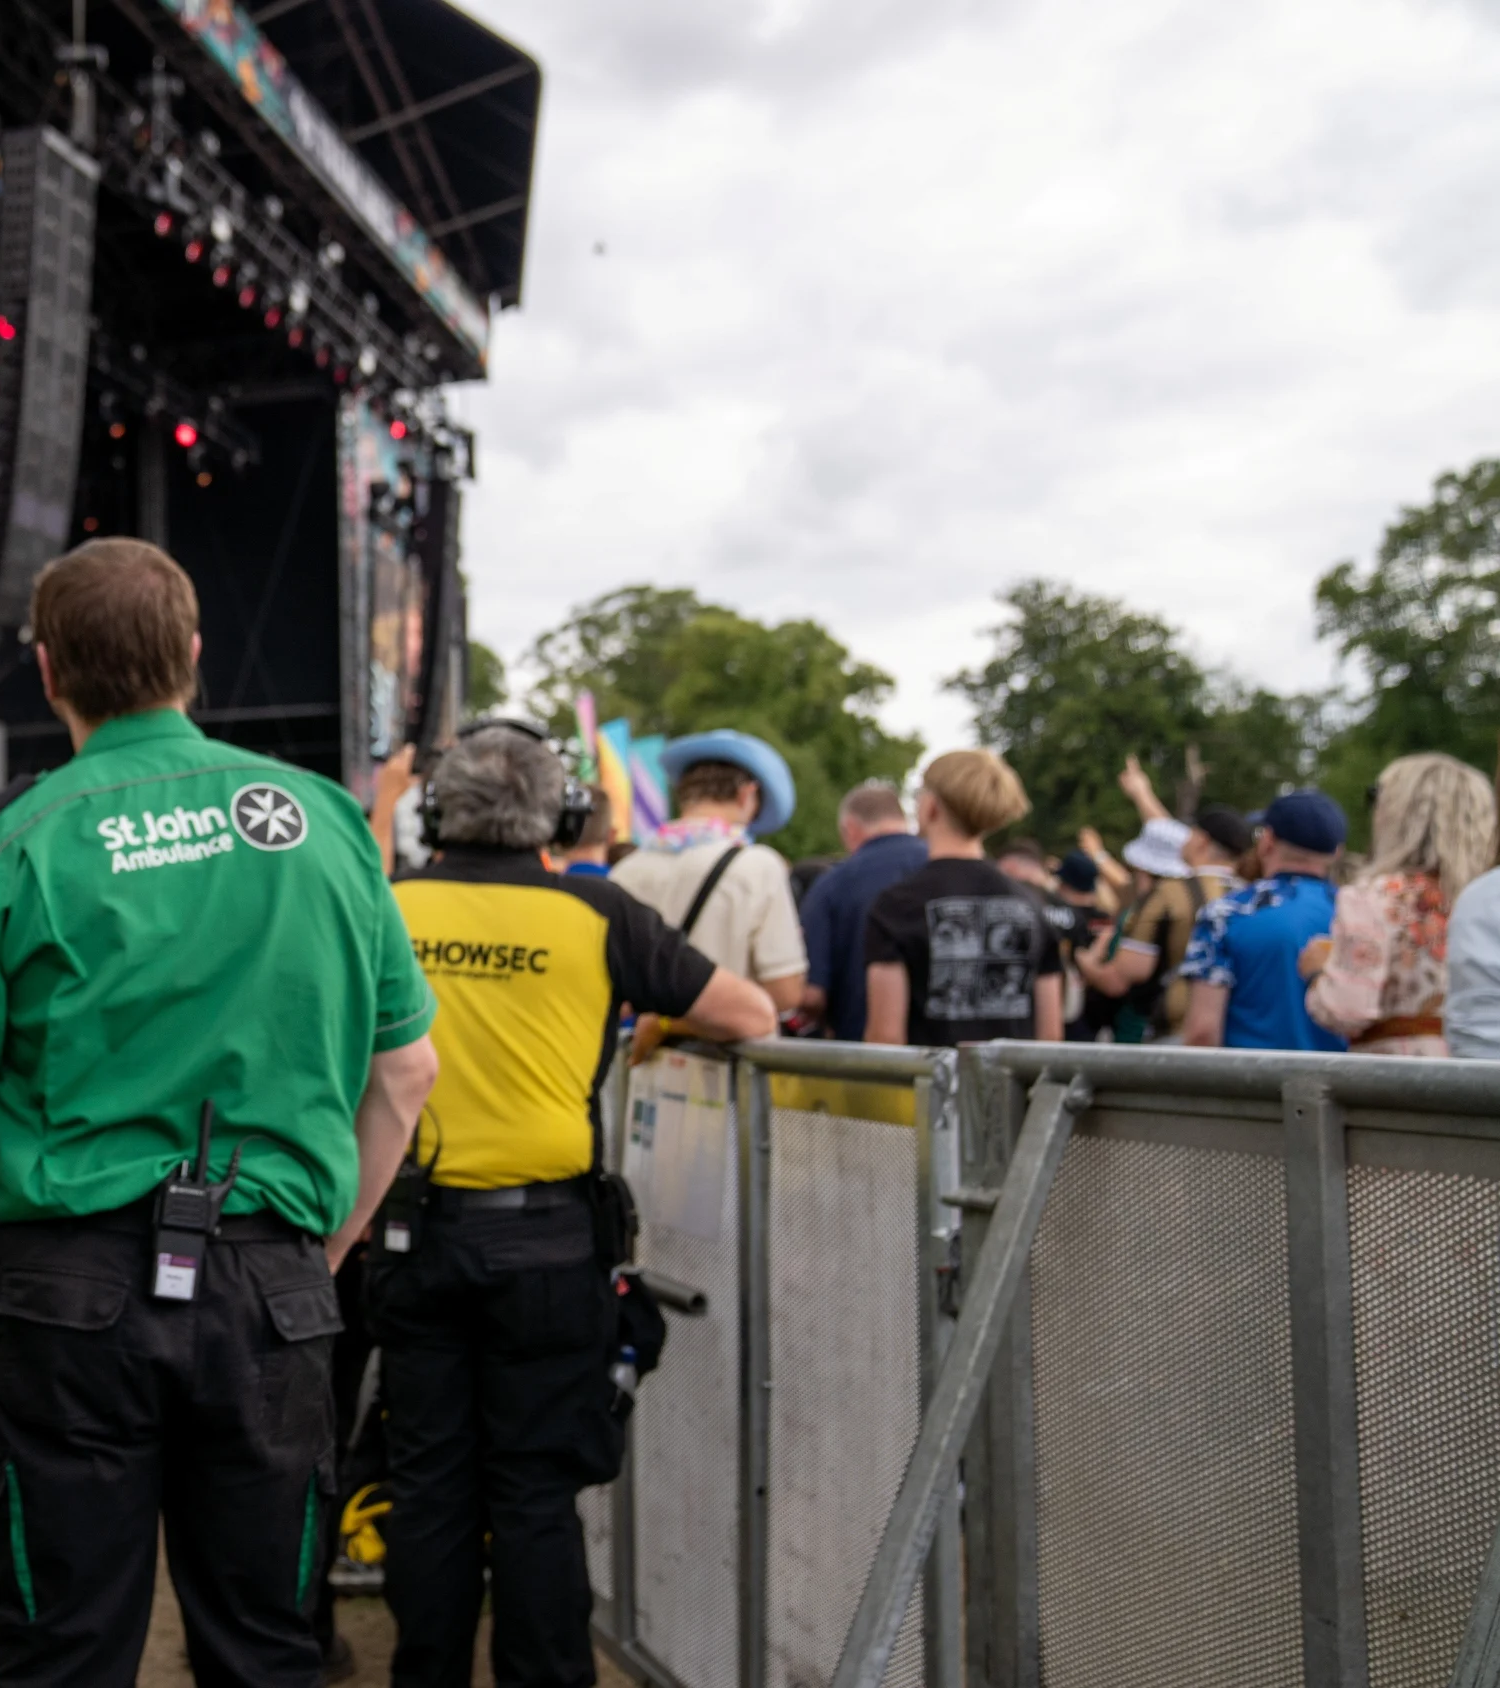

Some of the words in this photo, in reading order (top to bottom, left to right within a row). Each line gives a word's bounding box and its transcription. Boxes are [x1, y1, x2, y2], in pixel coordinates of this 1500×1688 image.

[97, 814, 142, 850] St
[142, 805, 229, 844] John
[111, 832, 235, 875] Ambulance
